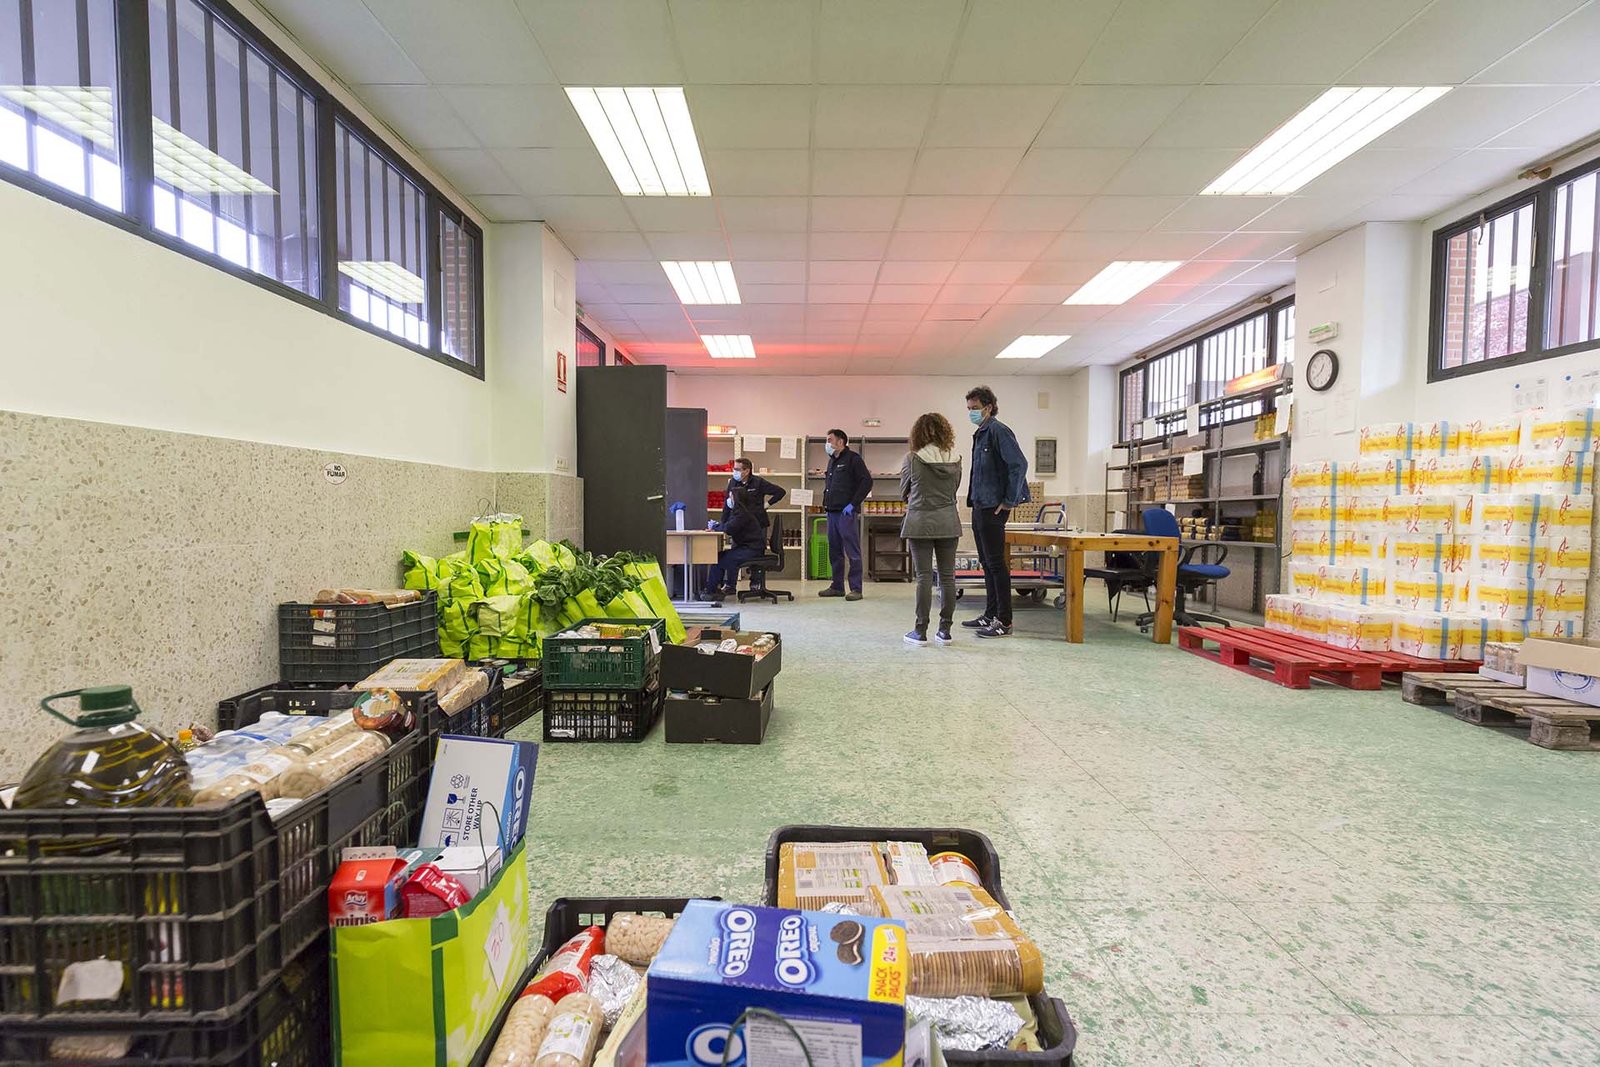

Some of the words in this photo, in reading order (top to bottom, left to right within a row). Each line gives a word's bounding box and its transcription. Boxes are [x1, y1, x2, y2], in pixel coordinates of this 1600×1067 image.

[467, 787, 479, 811] OTHER
[463, 812, 474, 841] STORE
[335, 913, 378, 927] minis
[724, 910, 754, 975] OREO
[779, 916, 809, 984] OREO
[874, 967, 888, 997] SNACK
